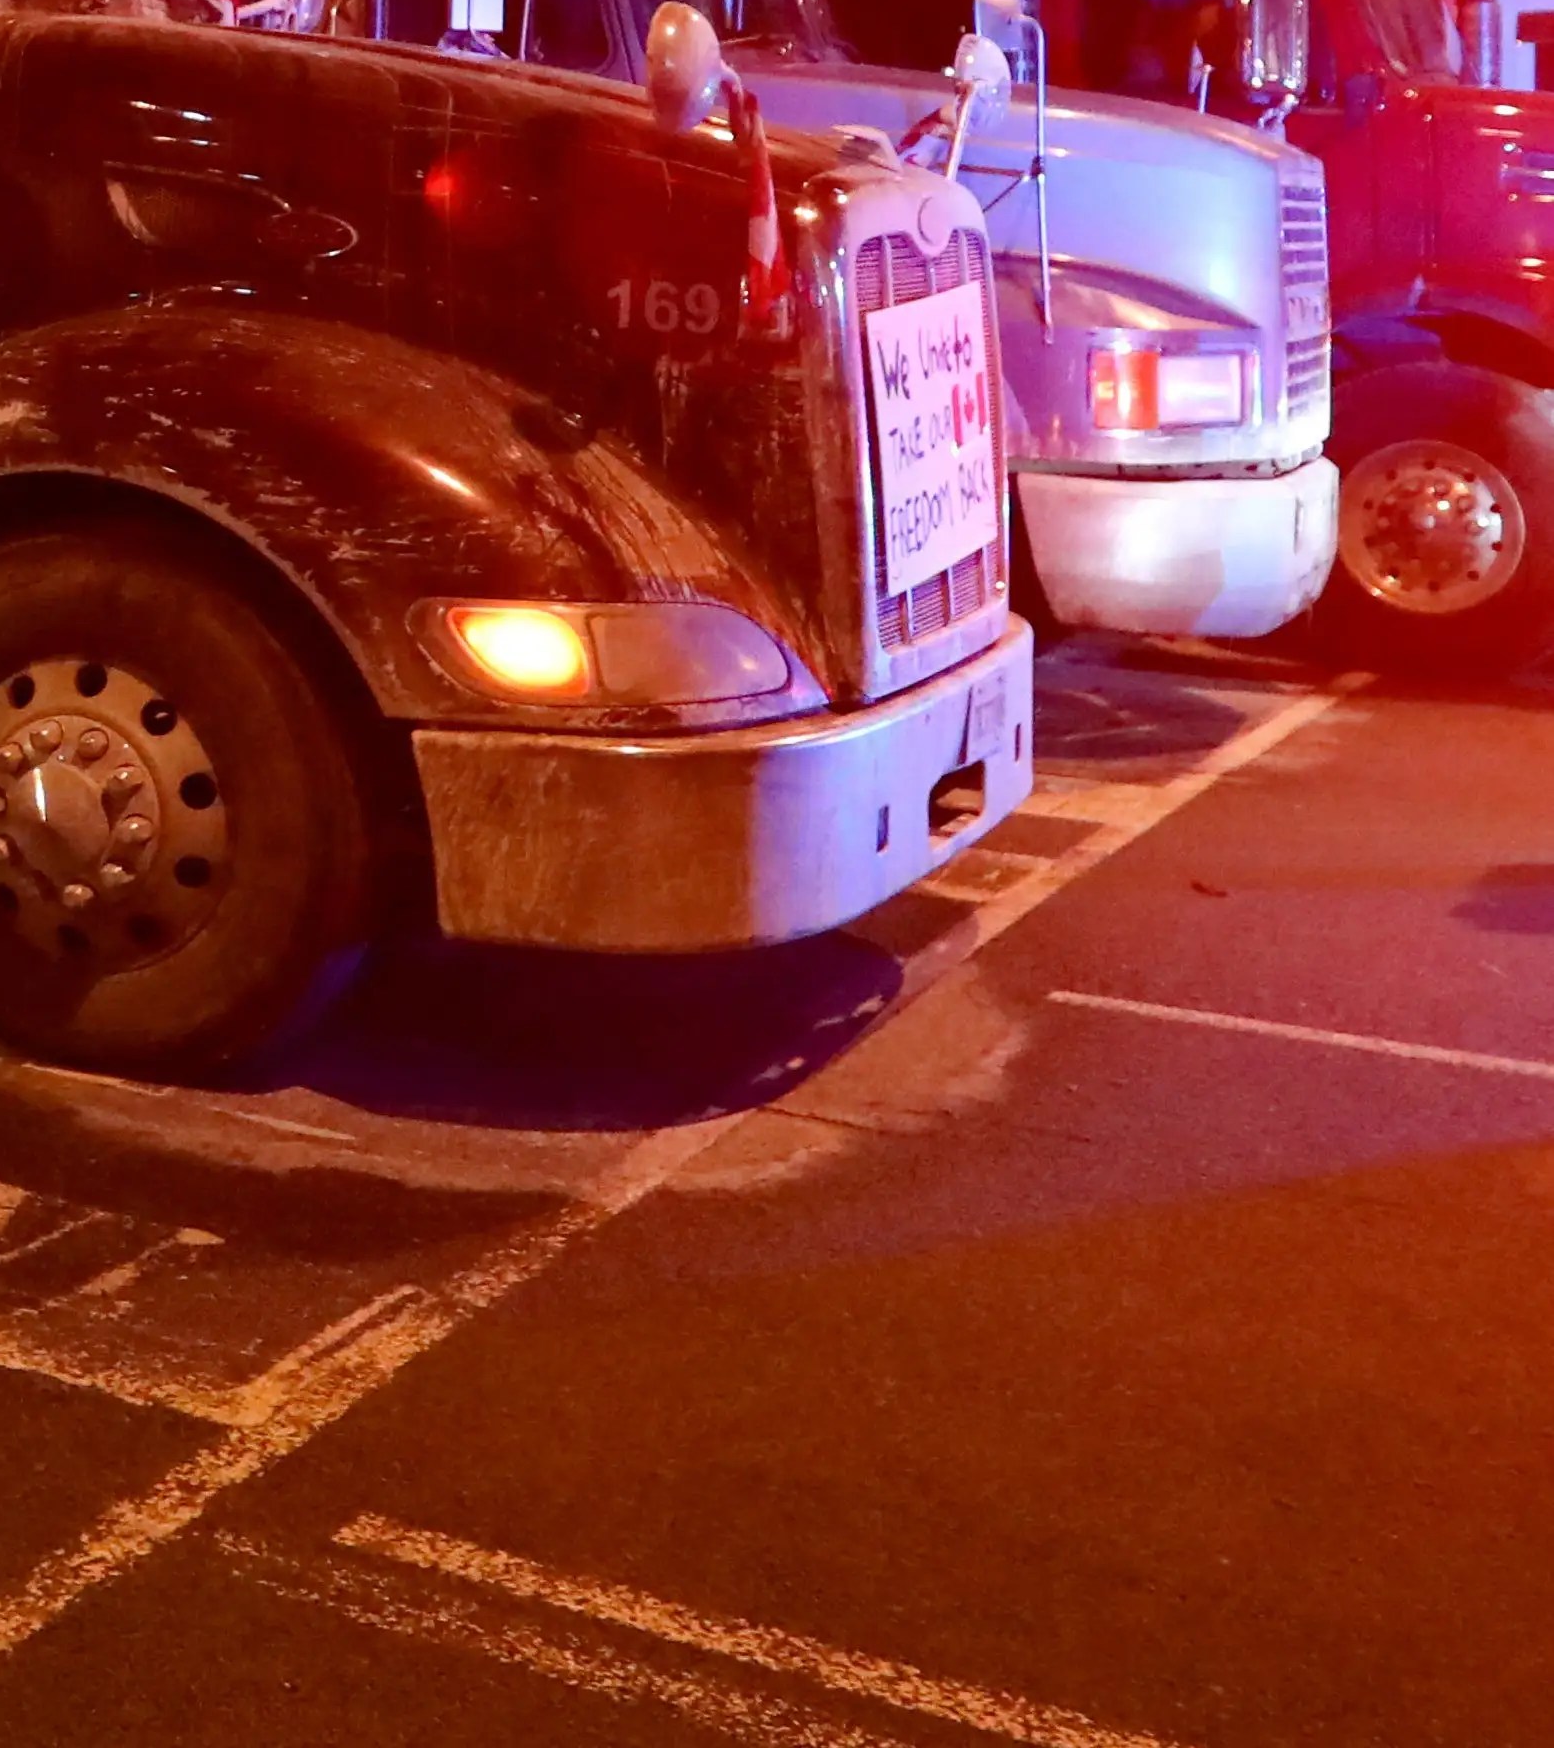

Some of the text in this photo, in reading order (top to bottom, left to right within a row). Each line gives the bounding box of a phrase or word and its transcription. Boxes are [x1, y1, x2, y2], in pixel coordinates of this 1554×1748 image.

[607, 278, 721, 334] 169
[876, 339, 911, 400] We
[889, 416, 925, 475] TAKE
[890, 480, 954, 562] FREEDOM
